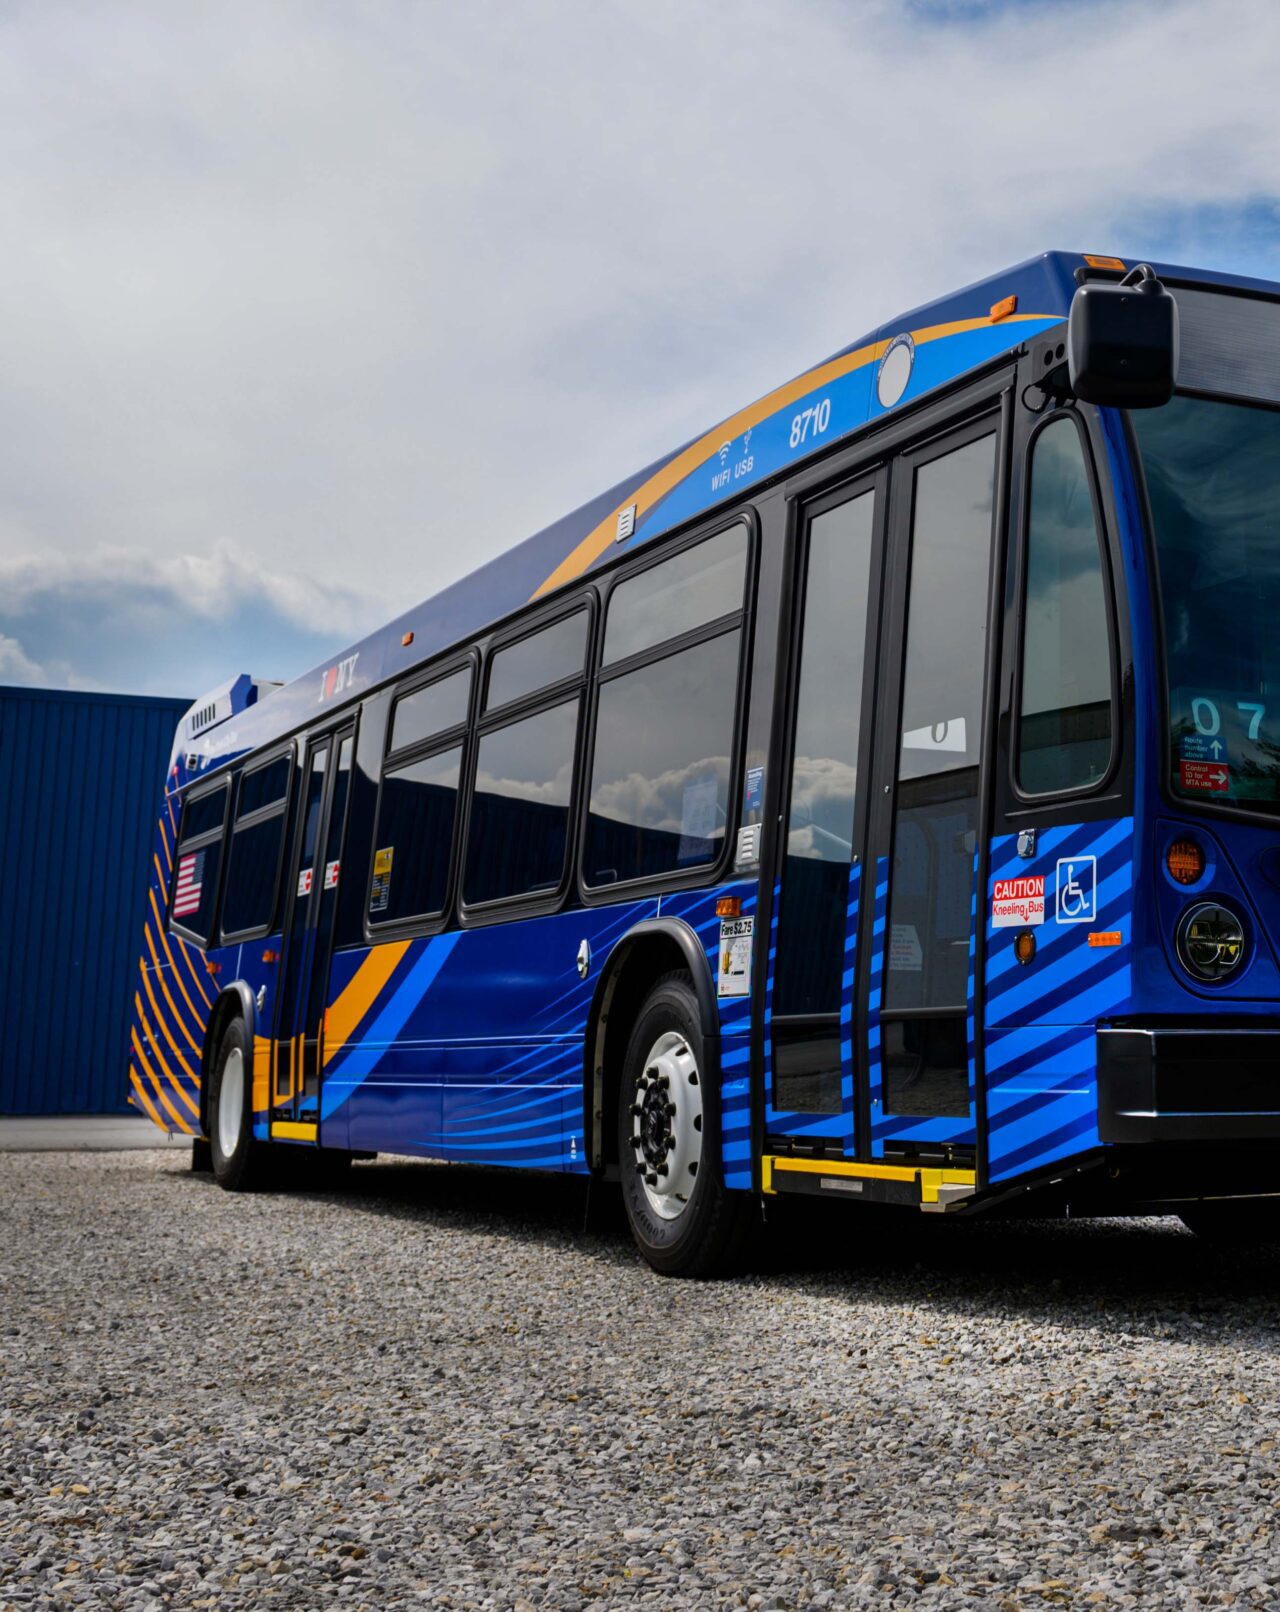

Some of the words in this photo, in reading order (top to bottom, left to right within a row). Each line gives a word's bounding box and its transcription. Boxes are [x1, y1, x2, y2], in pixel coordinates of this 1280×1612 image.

[789, 398, 831, 449] 8710
[711, 468, 731, 492] WIFI
[734, 456, 754, 479] USB
[334, 652, 360, 695] NY
[1191, 697, 1220, 736] 0
[1237, 701, 1265, 740] 7
[1185, 764, 1208, 772] Control
[994, 878, 1044, 899] CAUTION
[993, 902, 1025, 917] Kneeling
[1028, 900, 1044, 913] Bus
[721, 924, 734, 937] Fare
[733, 920, 752, 936] $2.75
